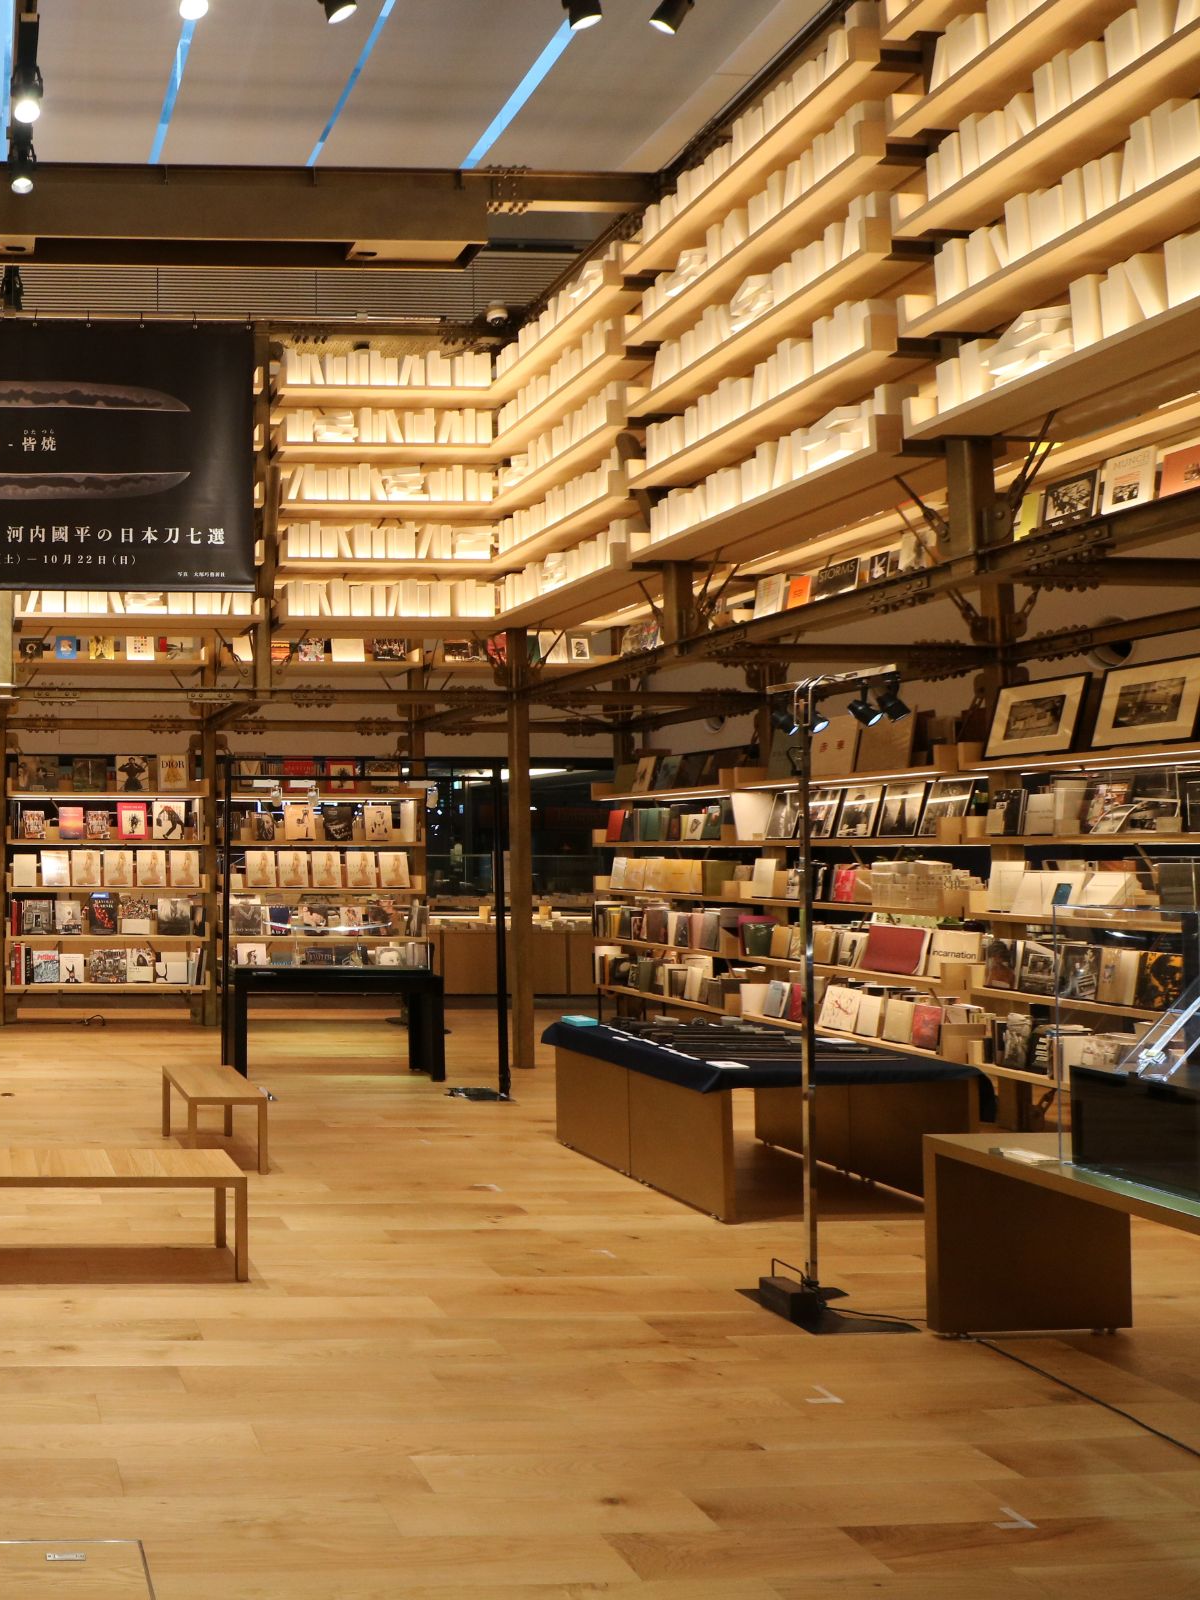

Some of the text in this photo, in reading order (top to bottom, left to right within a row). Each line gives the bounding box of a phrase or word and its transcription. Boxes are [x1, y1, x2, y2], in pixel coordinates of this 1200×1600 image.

[1113, 452, 1151, 470] MUNCH
[6, 525, 226, 545] 河内國平の日本刀七選
[818, 560, 856, 584] STORMS
[161, 760, 185, 769] DIOR
[932, 949, 977, 960] incarnation
